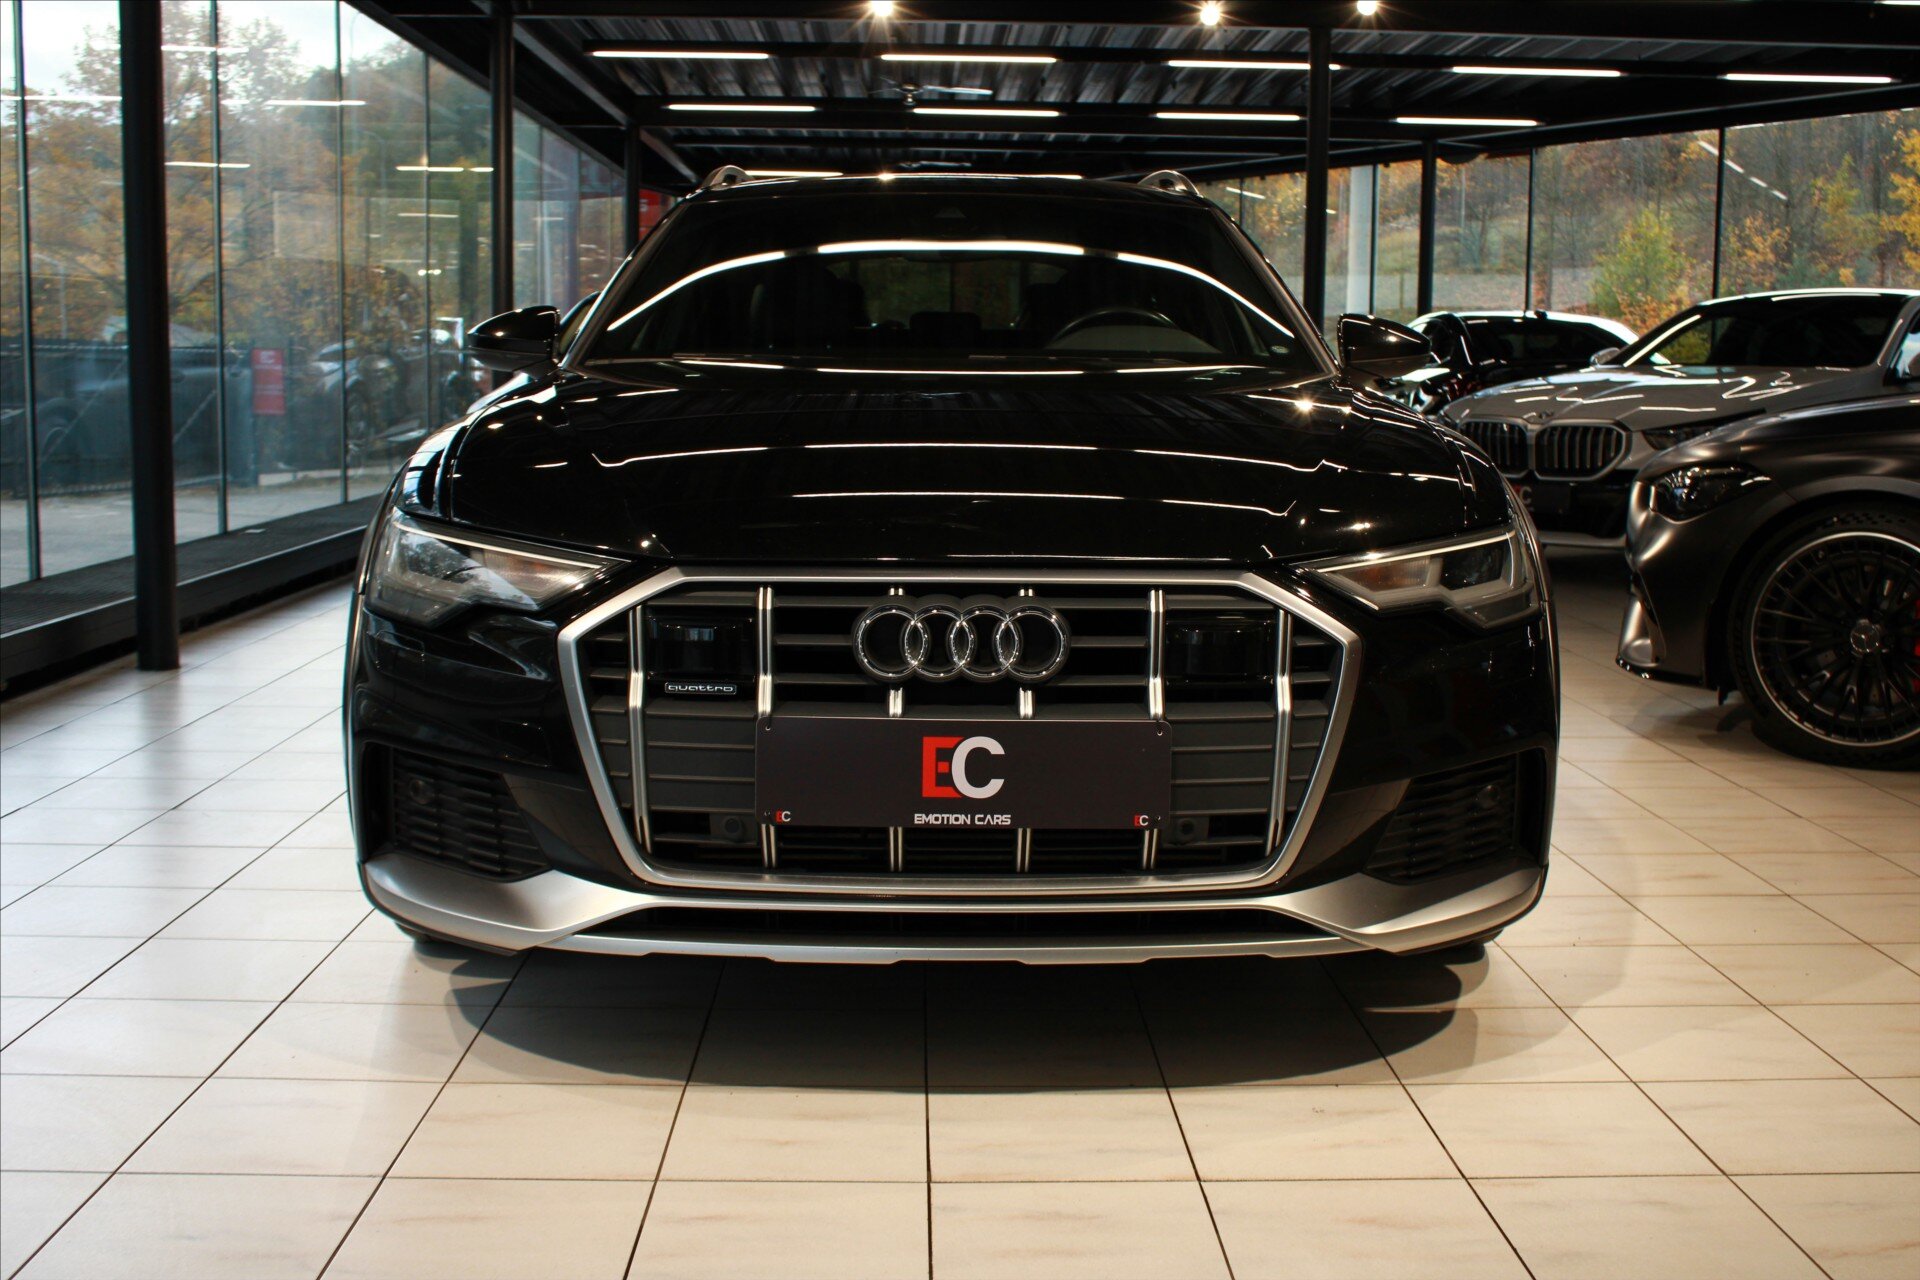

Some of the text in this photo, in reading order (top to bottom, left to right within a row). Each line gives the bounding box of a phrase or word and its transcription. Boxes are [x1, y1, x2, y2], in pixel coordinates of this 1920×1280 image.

[667, 683, 734, 693] quattro
[922, 736, 1005, 799] EC
[776, 811, 791, 823] EC
[914, 813, 1012, 826] EMOTION CARS
[1134, 814, 1149, 827] EC
